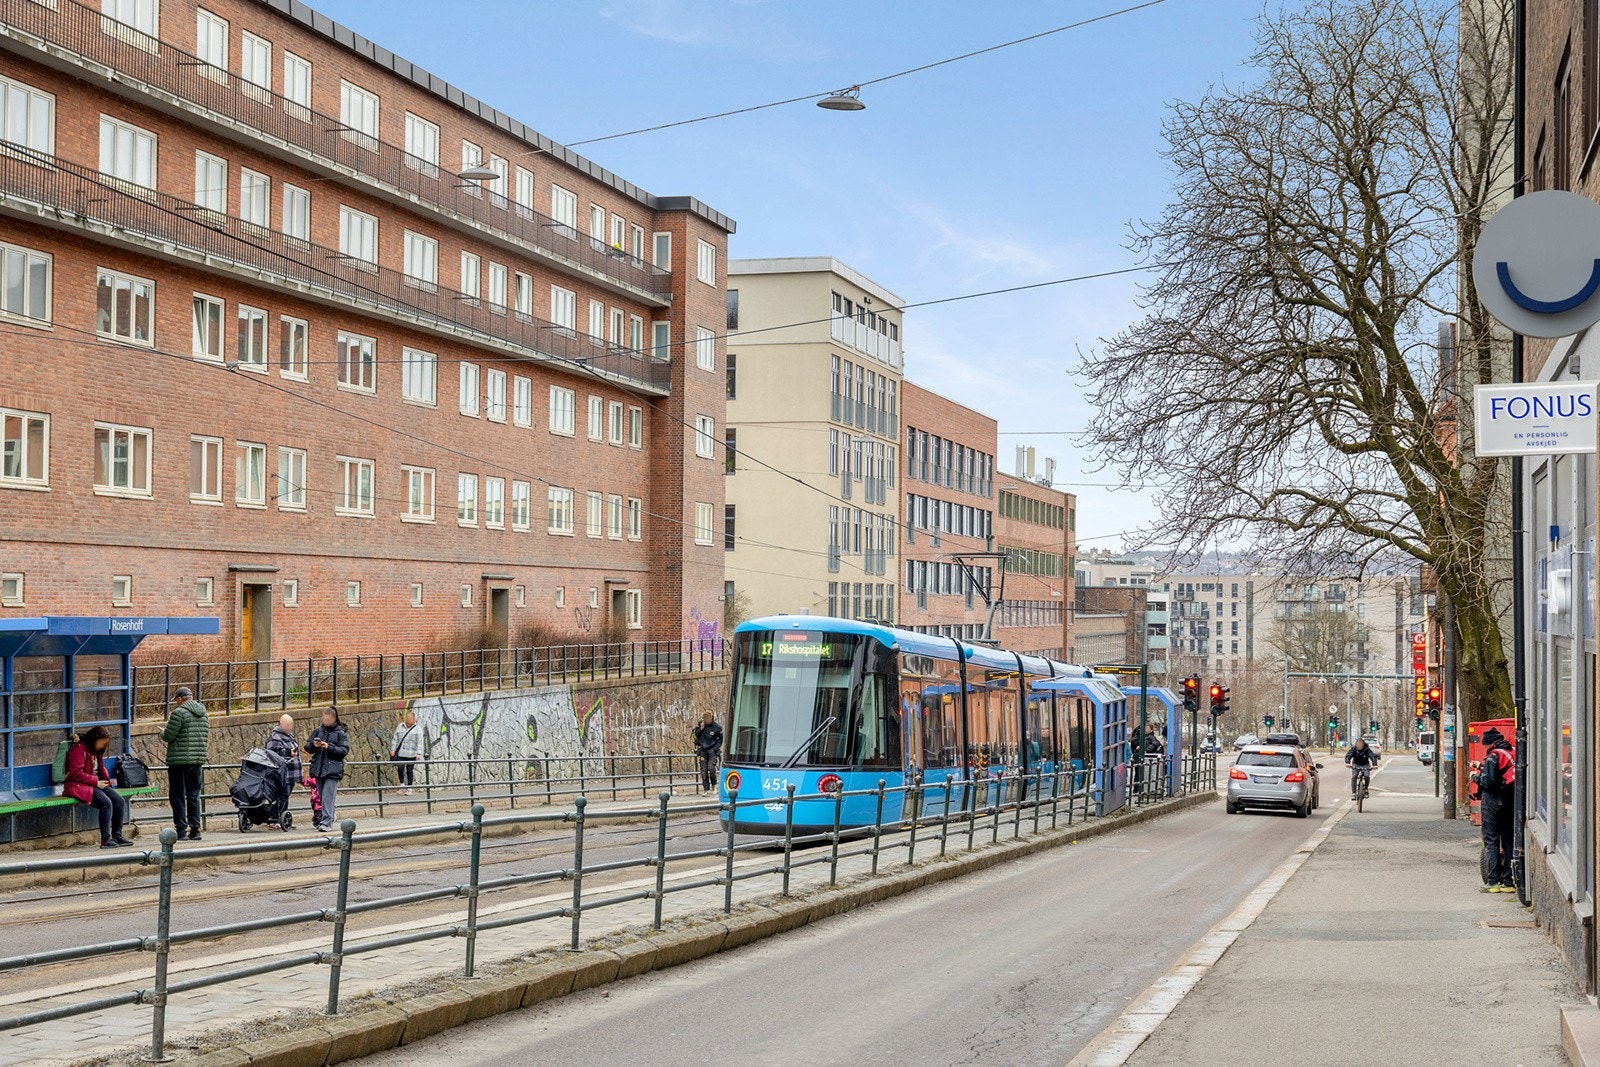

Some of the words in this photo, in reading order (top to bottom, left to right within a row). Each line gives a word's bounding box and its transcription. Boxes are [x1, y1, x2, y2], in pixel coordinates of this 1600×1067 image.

[1491, 394, 1592, 420] FONUS
[112, 618, 144, 631] Rosenhoff
[761, 643, 773, 655] 17
[779, 643, 830, 656] Rikshospitalet
[763, 778, 788, 791] 451
